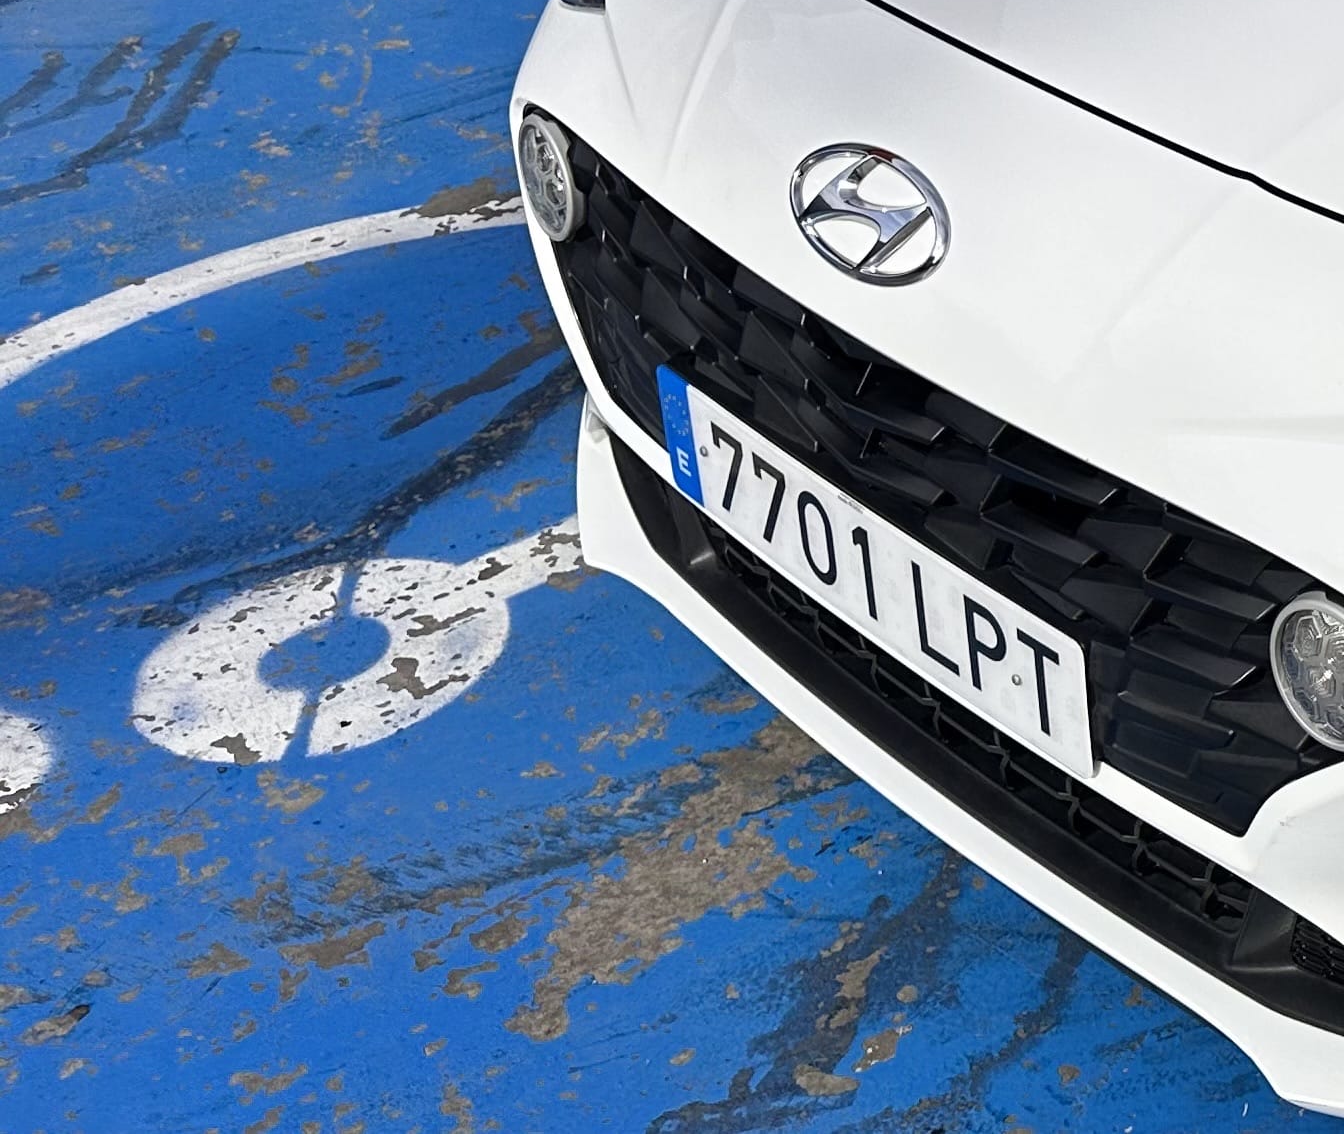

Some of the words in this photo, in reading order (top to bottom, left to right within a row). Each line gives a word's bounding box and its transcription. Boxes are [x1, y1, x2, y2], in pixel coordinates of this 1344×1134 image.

[675, 446, 692, 478] E
[710, 421, 878, 622] 7701
[911, 559, 1060, 737] LPT
